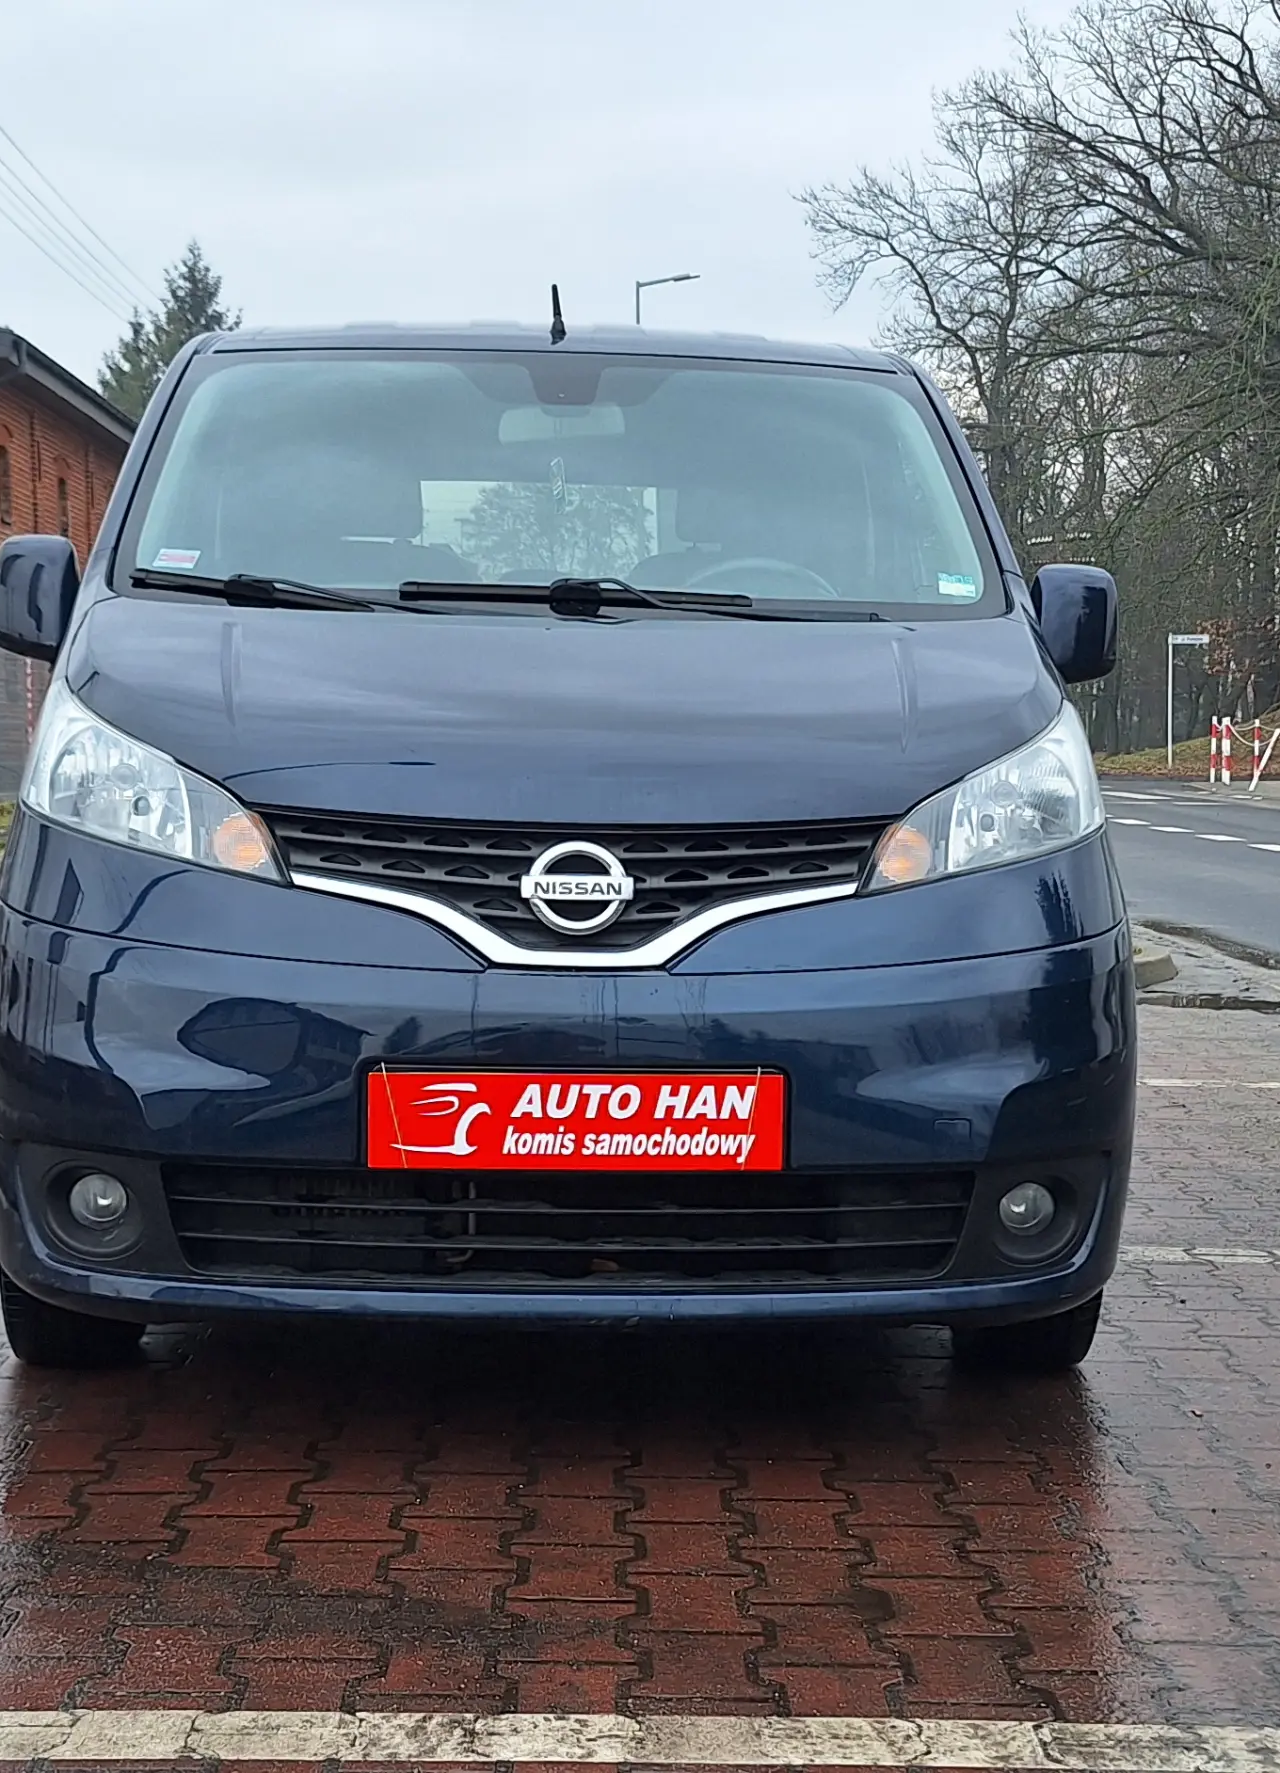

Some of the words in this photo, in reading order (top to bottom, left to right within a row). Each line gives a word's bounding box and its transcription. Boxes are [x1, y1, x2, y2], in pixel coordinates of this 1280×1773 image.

[534, 881, 622, 896] NISSAN
[510, 1083, 641, 1120] AUTO
[654, 1083, 757, 1120] HAN
[502, 1126, 574, 1156] komis
[581, 1127, 755, 1163] samochodowy
